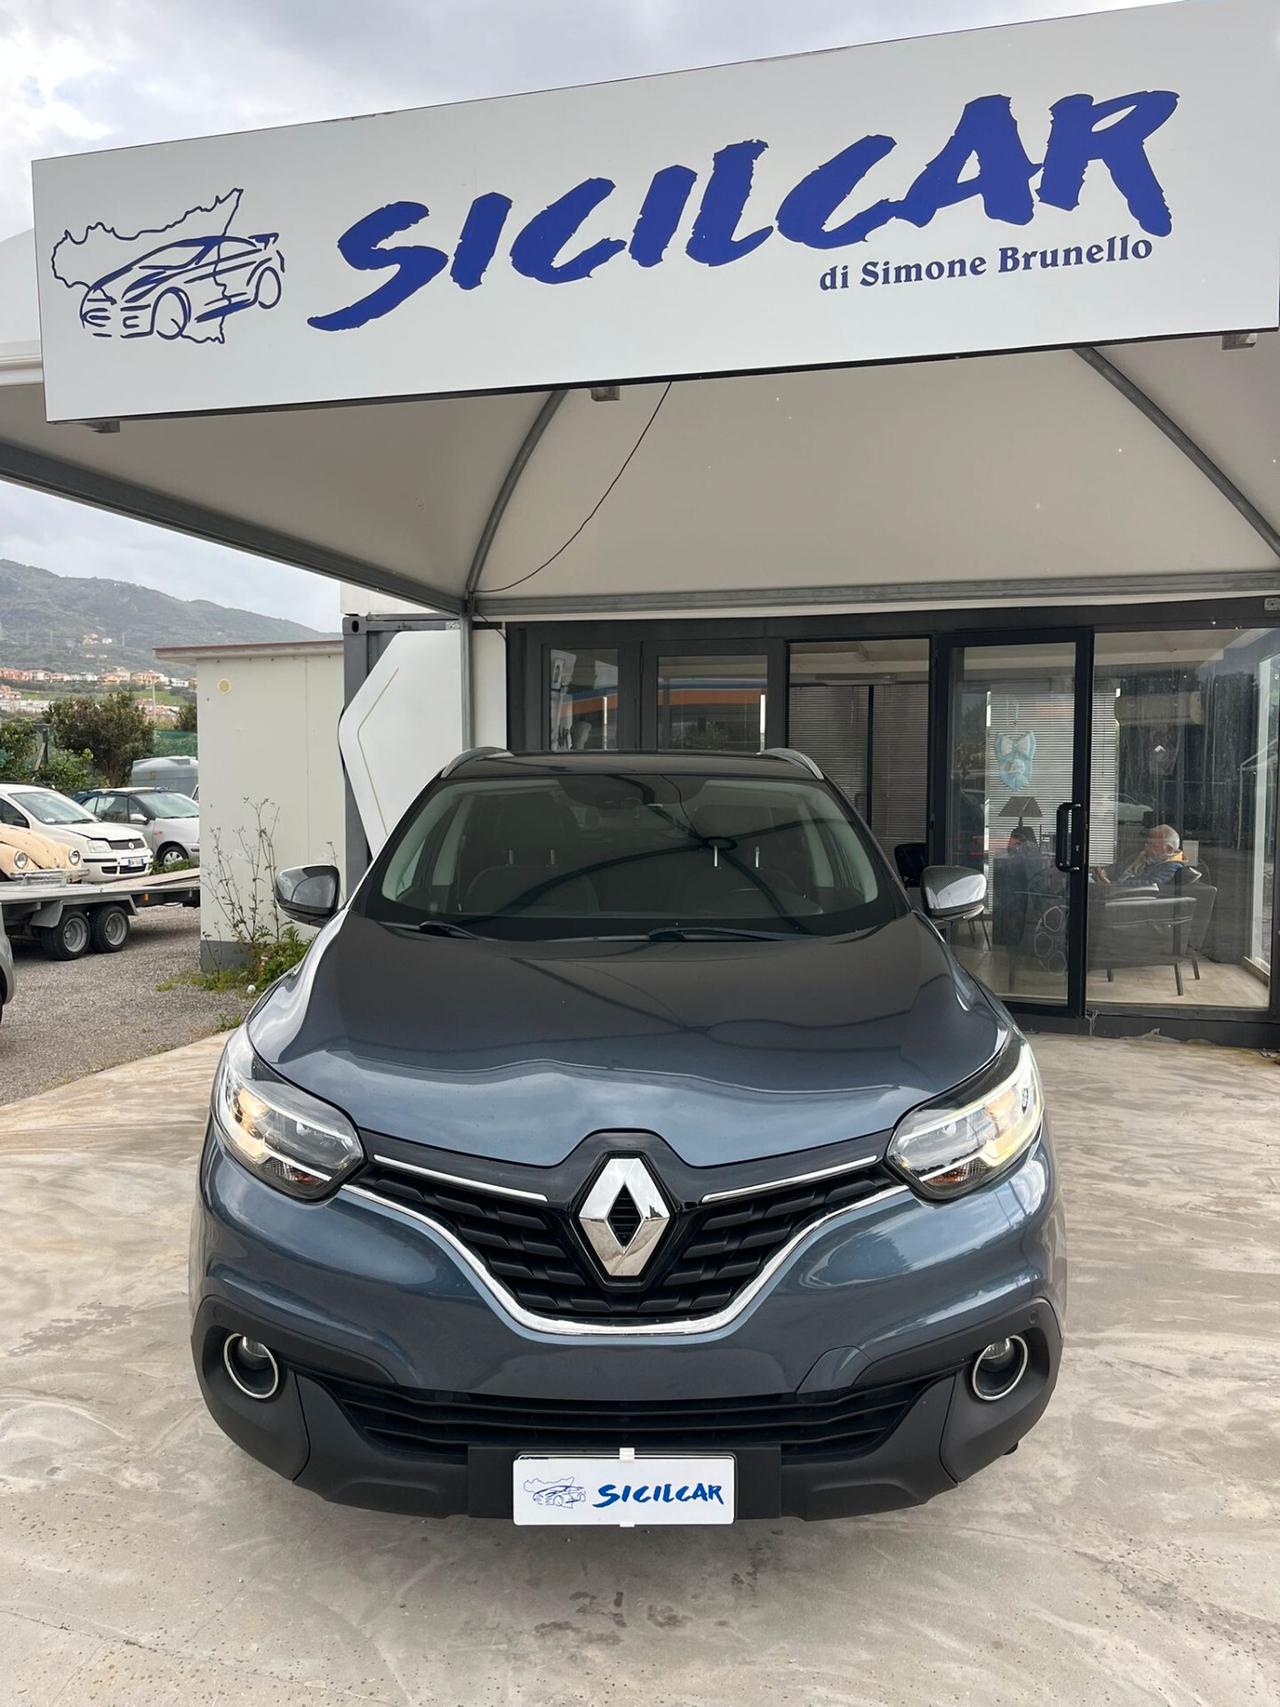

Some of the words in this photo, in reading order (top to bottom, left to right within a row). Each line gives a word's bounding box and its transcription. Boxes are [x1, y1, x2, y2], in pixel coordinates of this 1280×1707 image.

[307, 90, 1179, 332] SICILCAR
[819, 264, 849, 291] di
[859, 256, 987, 287] Simone
[997, 234, 1153, 273] Brunello
[592, 1483, 724, 1508] SICILCAR
